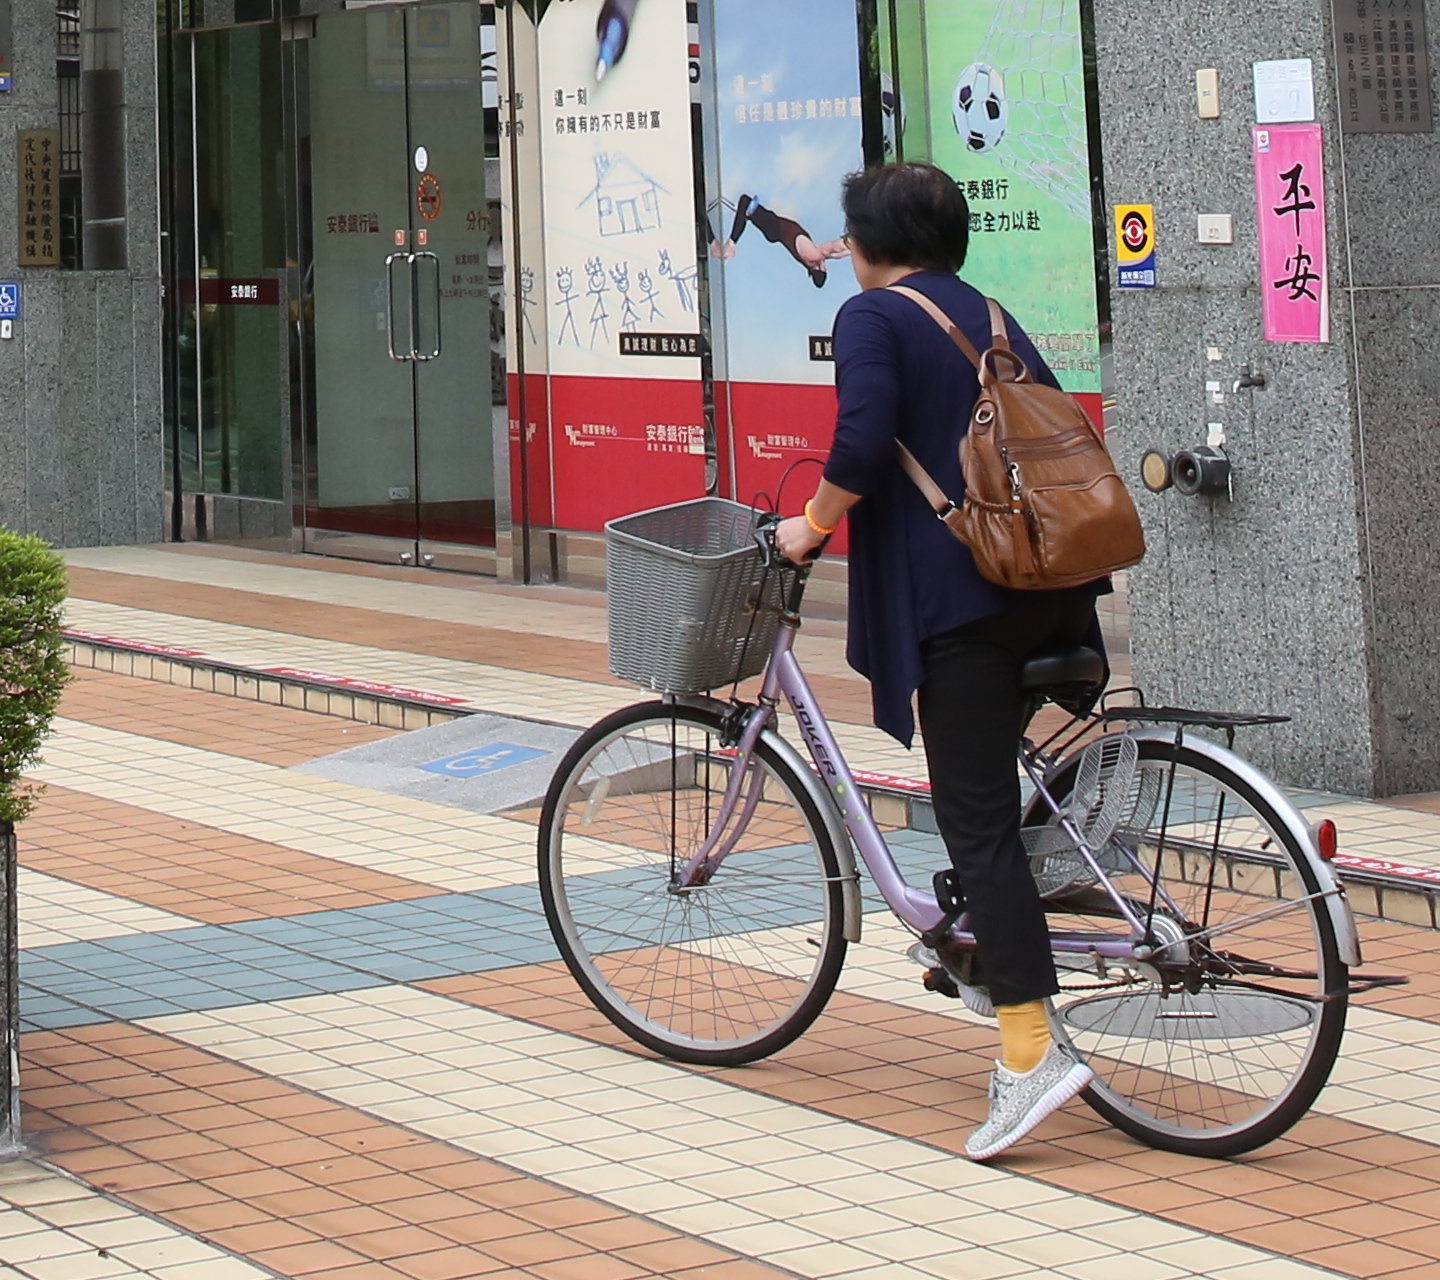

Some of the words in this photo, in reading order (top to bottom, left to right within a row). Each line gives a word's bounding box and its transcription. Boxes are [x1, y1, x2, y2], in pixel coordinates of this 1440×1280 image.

[554, 87, 588, 108] 這一刻
[555, 110, 661, 136] 你擁有的不只是財富
[326, 214, 369, 234] 安泰銀行
[230, 284, 258, 299] 安泰銀行
[646, 424, 687, 444] 安泰銀行
[791, 695, 837, 777] JOKER
